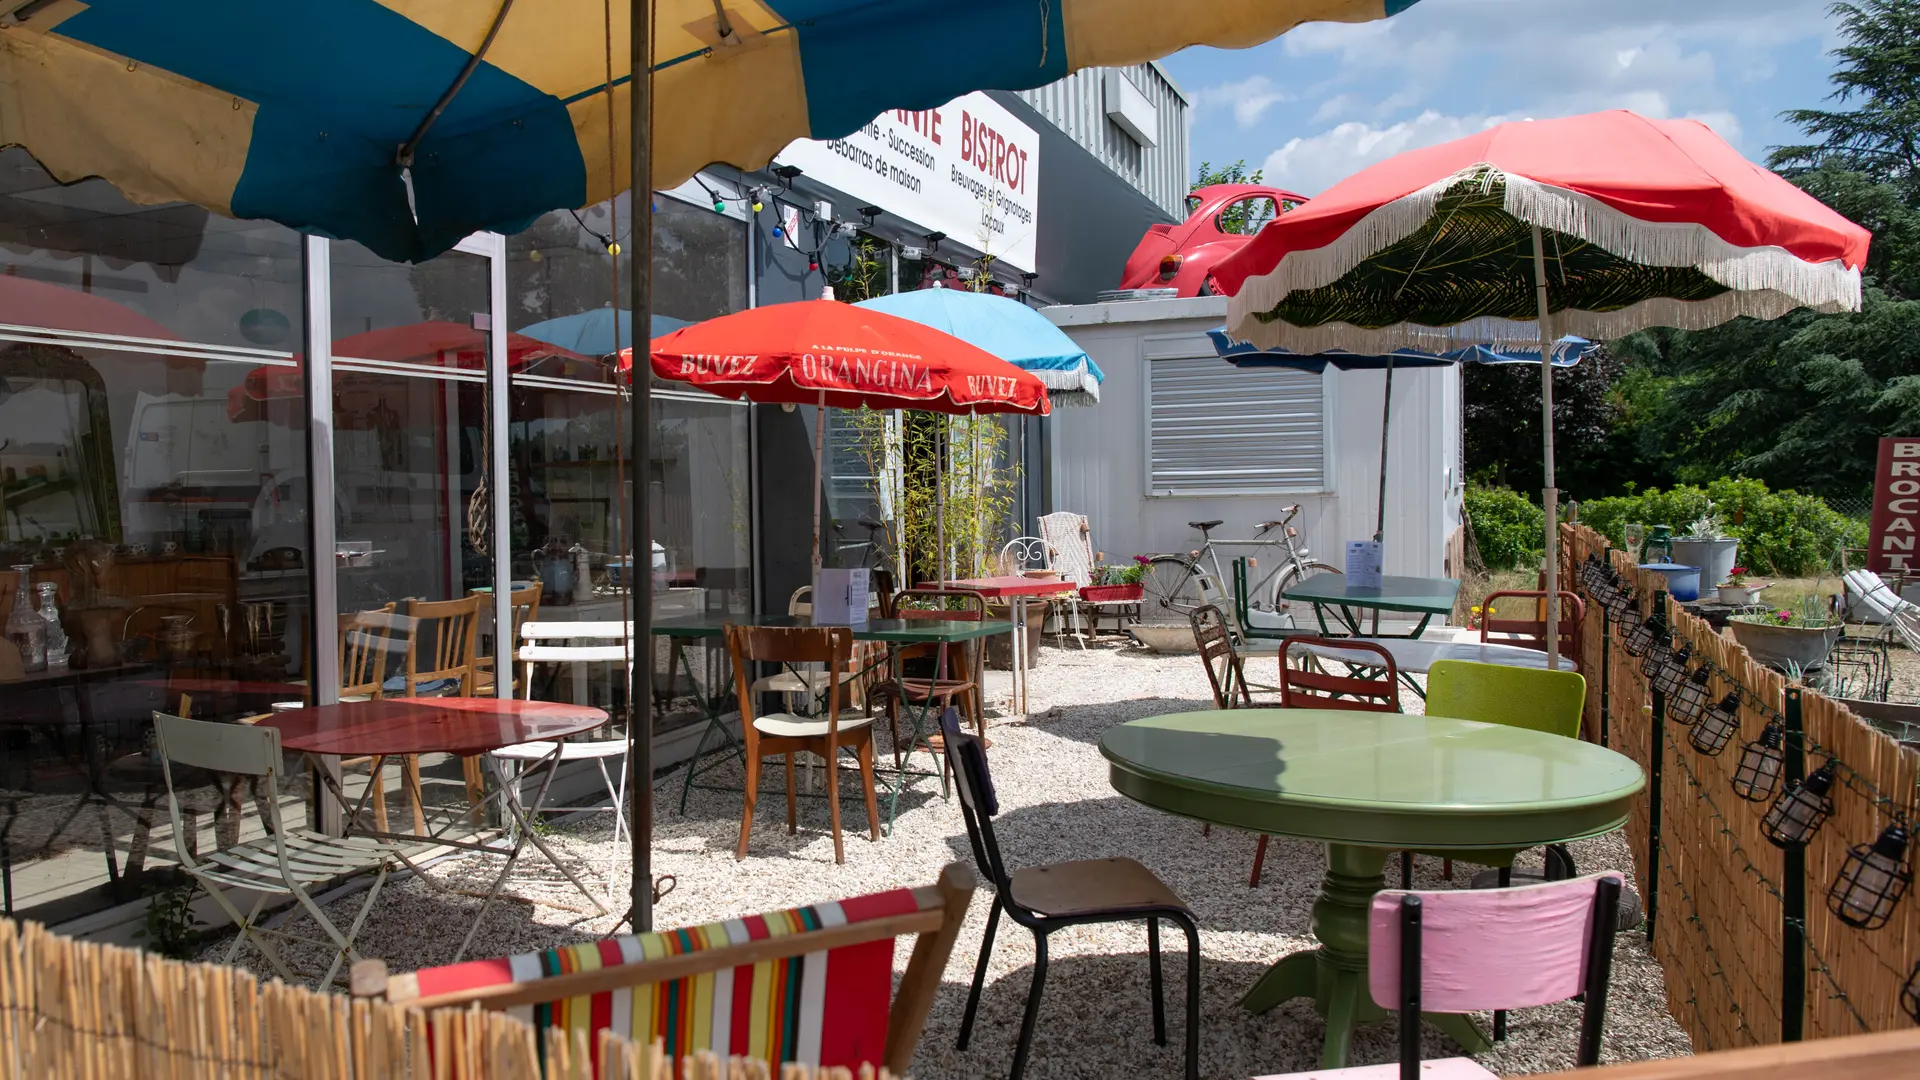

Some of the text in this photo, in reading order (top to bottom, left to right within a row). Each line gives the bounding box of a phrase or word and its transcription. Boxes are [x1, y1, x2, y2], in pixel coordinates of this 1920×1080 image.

[888, 127, 935, 171] Succession
[961, 109, 1028, 195] BISTROT
[875, 154, 888, 178] de
[889, 164, 921, 194] maison
[951, 163, 987, 200] Breuvages
[995, 189, 1032, 224] Grignotages
[981, 207, 1005, 235] Locaux
[680, 353, 758, 375] BUVEZ
[836, 346, 867, 354] PULPE
[802, 353, 932, 392] ORANGINA
[967, 374, 1017, 398] BUVEZ
